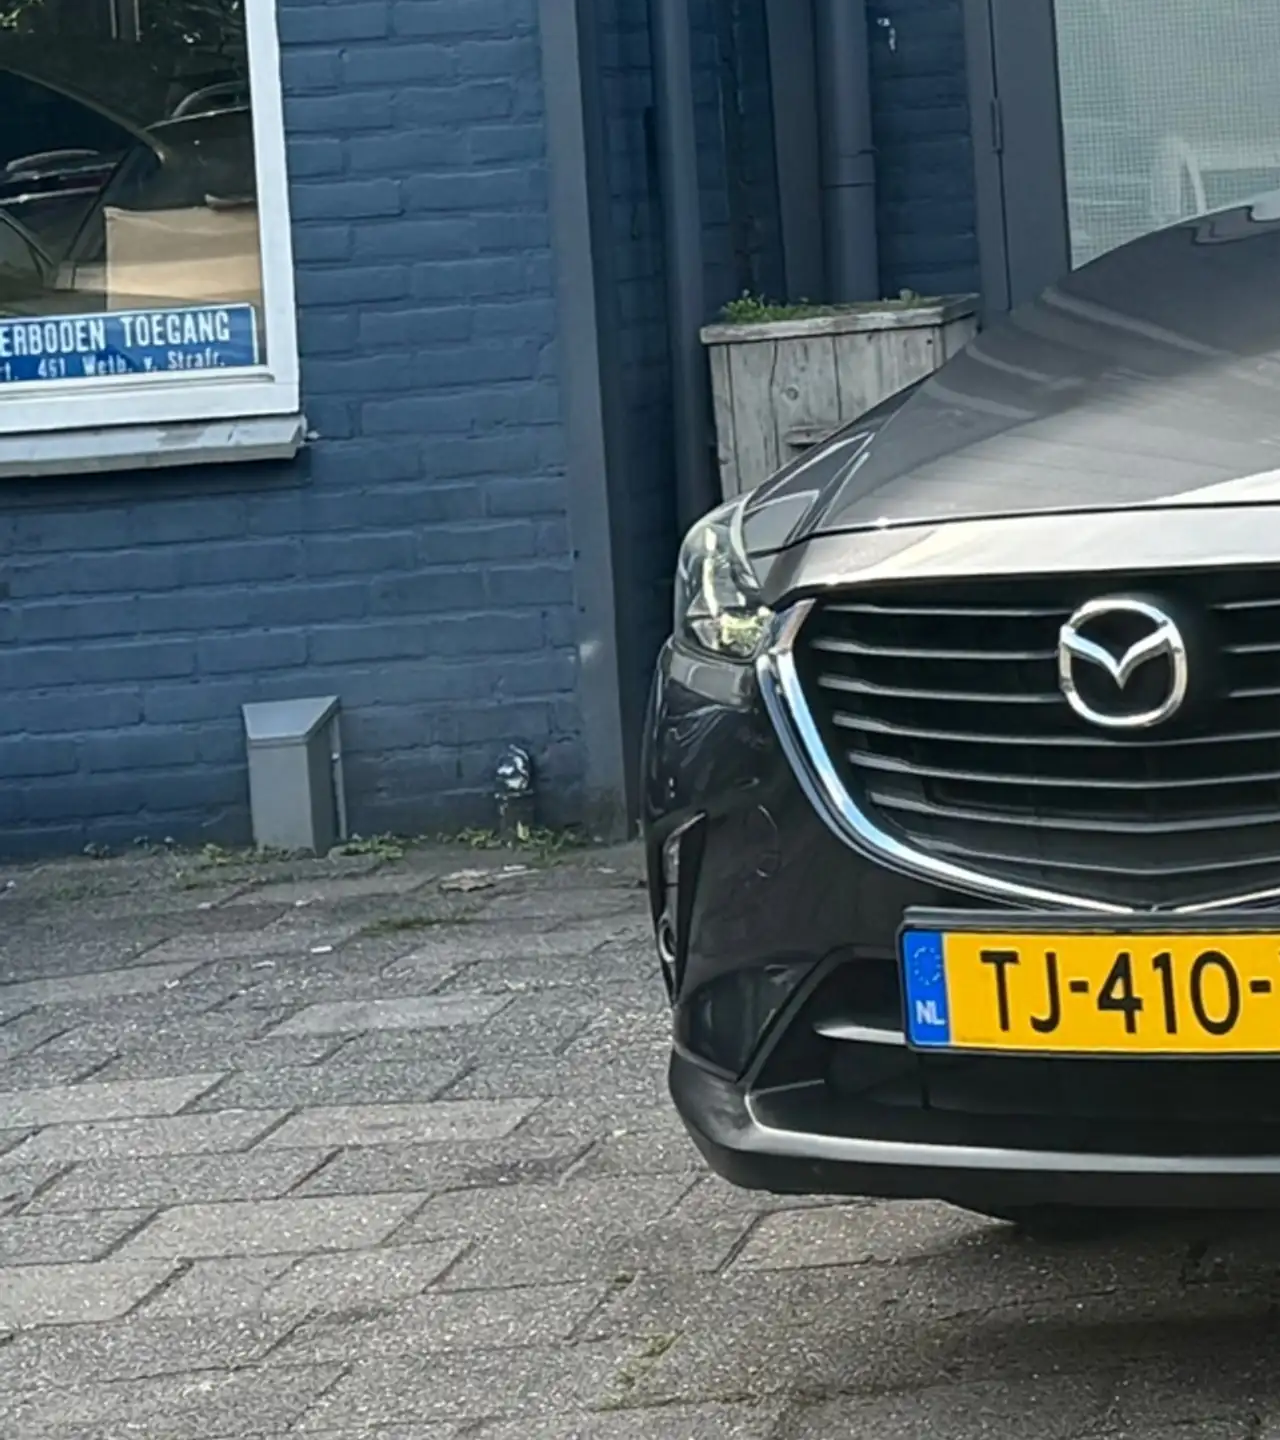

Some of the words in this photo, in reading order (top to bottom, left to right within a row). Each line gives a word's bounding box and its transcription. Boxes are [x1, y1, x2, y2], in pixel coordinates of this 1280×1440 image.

[0, 318, 106, 357] ERBODEN
[119, 310, 230, 347] TOEGANG
[915, 999, 946, 1026] NL
